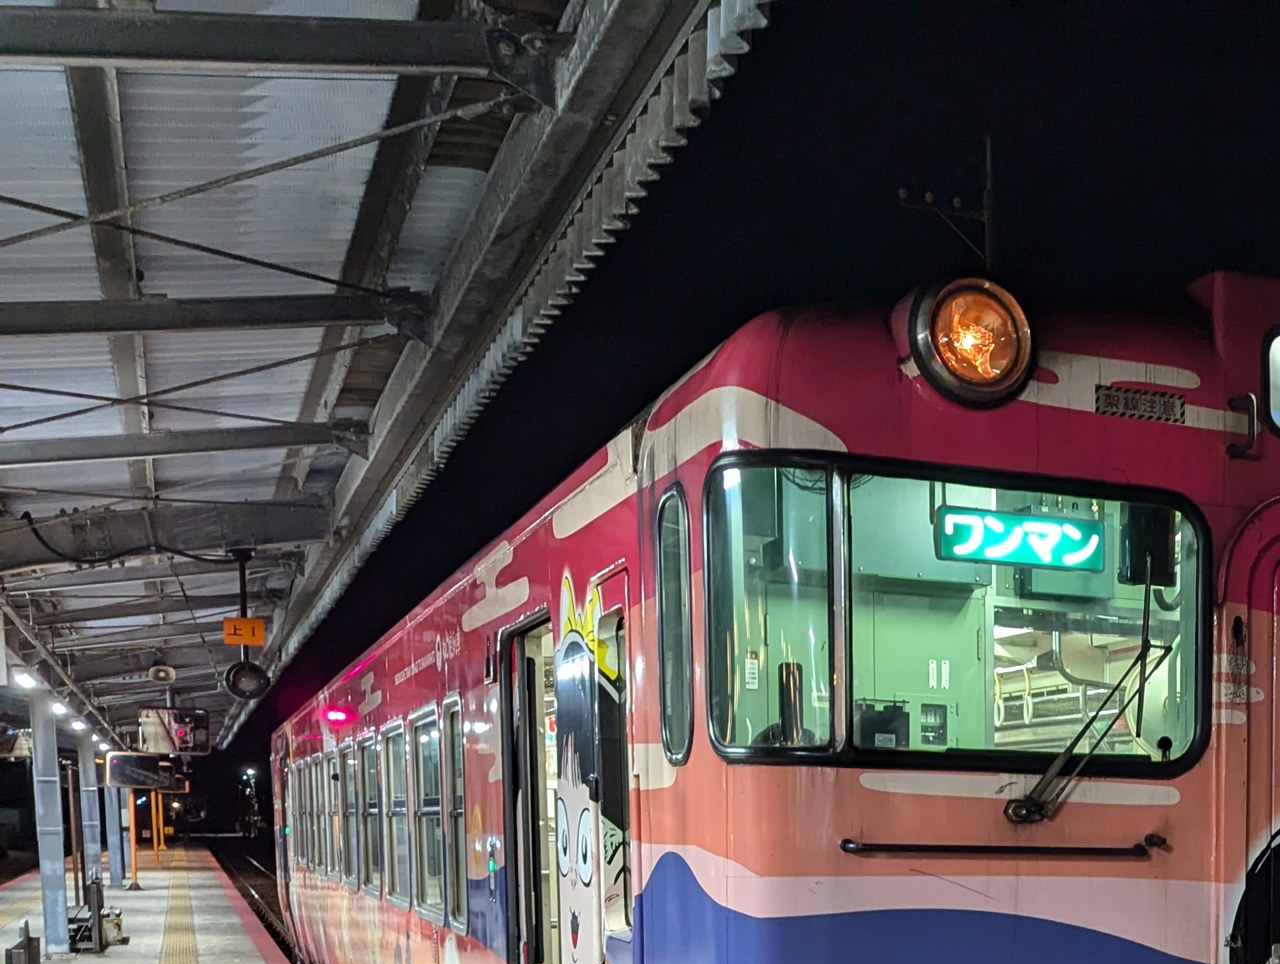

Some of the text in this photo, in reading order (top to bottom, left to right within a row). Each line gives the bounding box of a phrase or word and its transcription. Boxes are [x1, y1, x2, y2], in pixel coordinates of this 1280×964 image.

[1103, 392, 1177, 417] 架線注意
[944, 514, 1100, 565] ワンマン
[226, 624, 244, 637] 上
